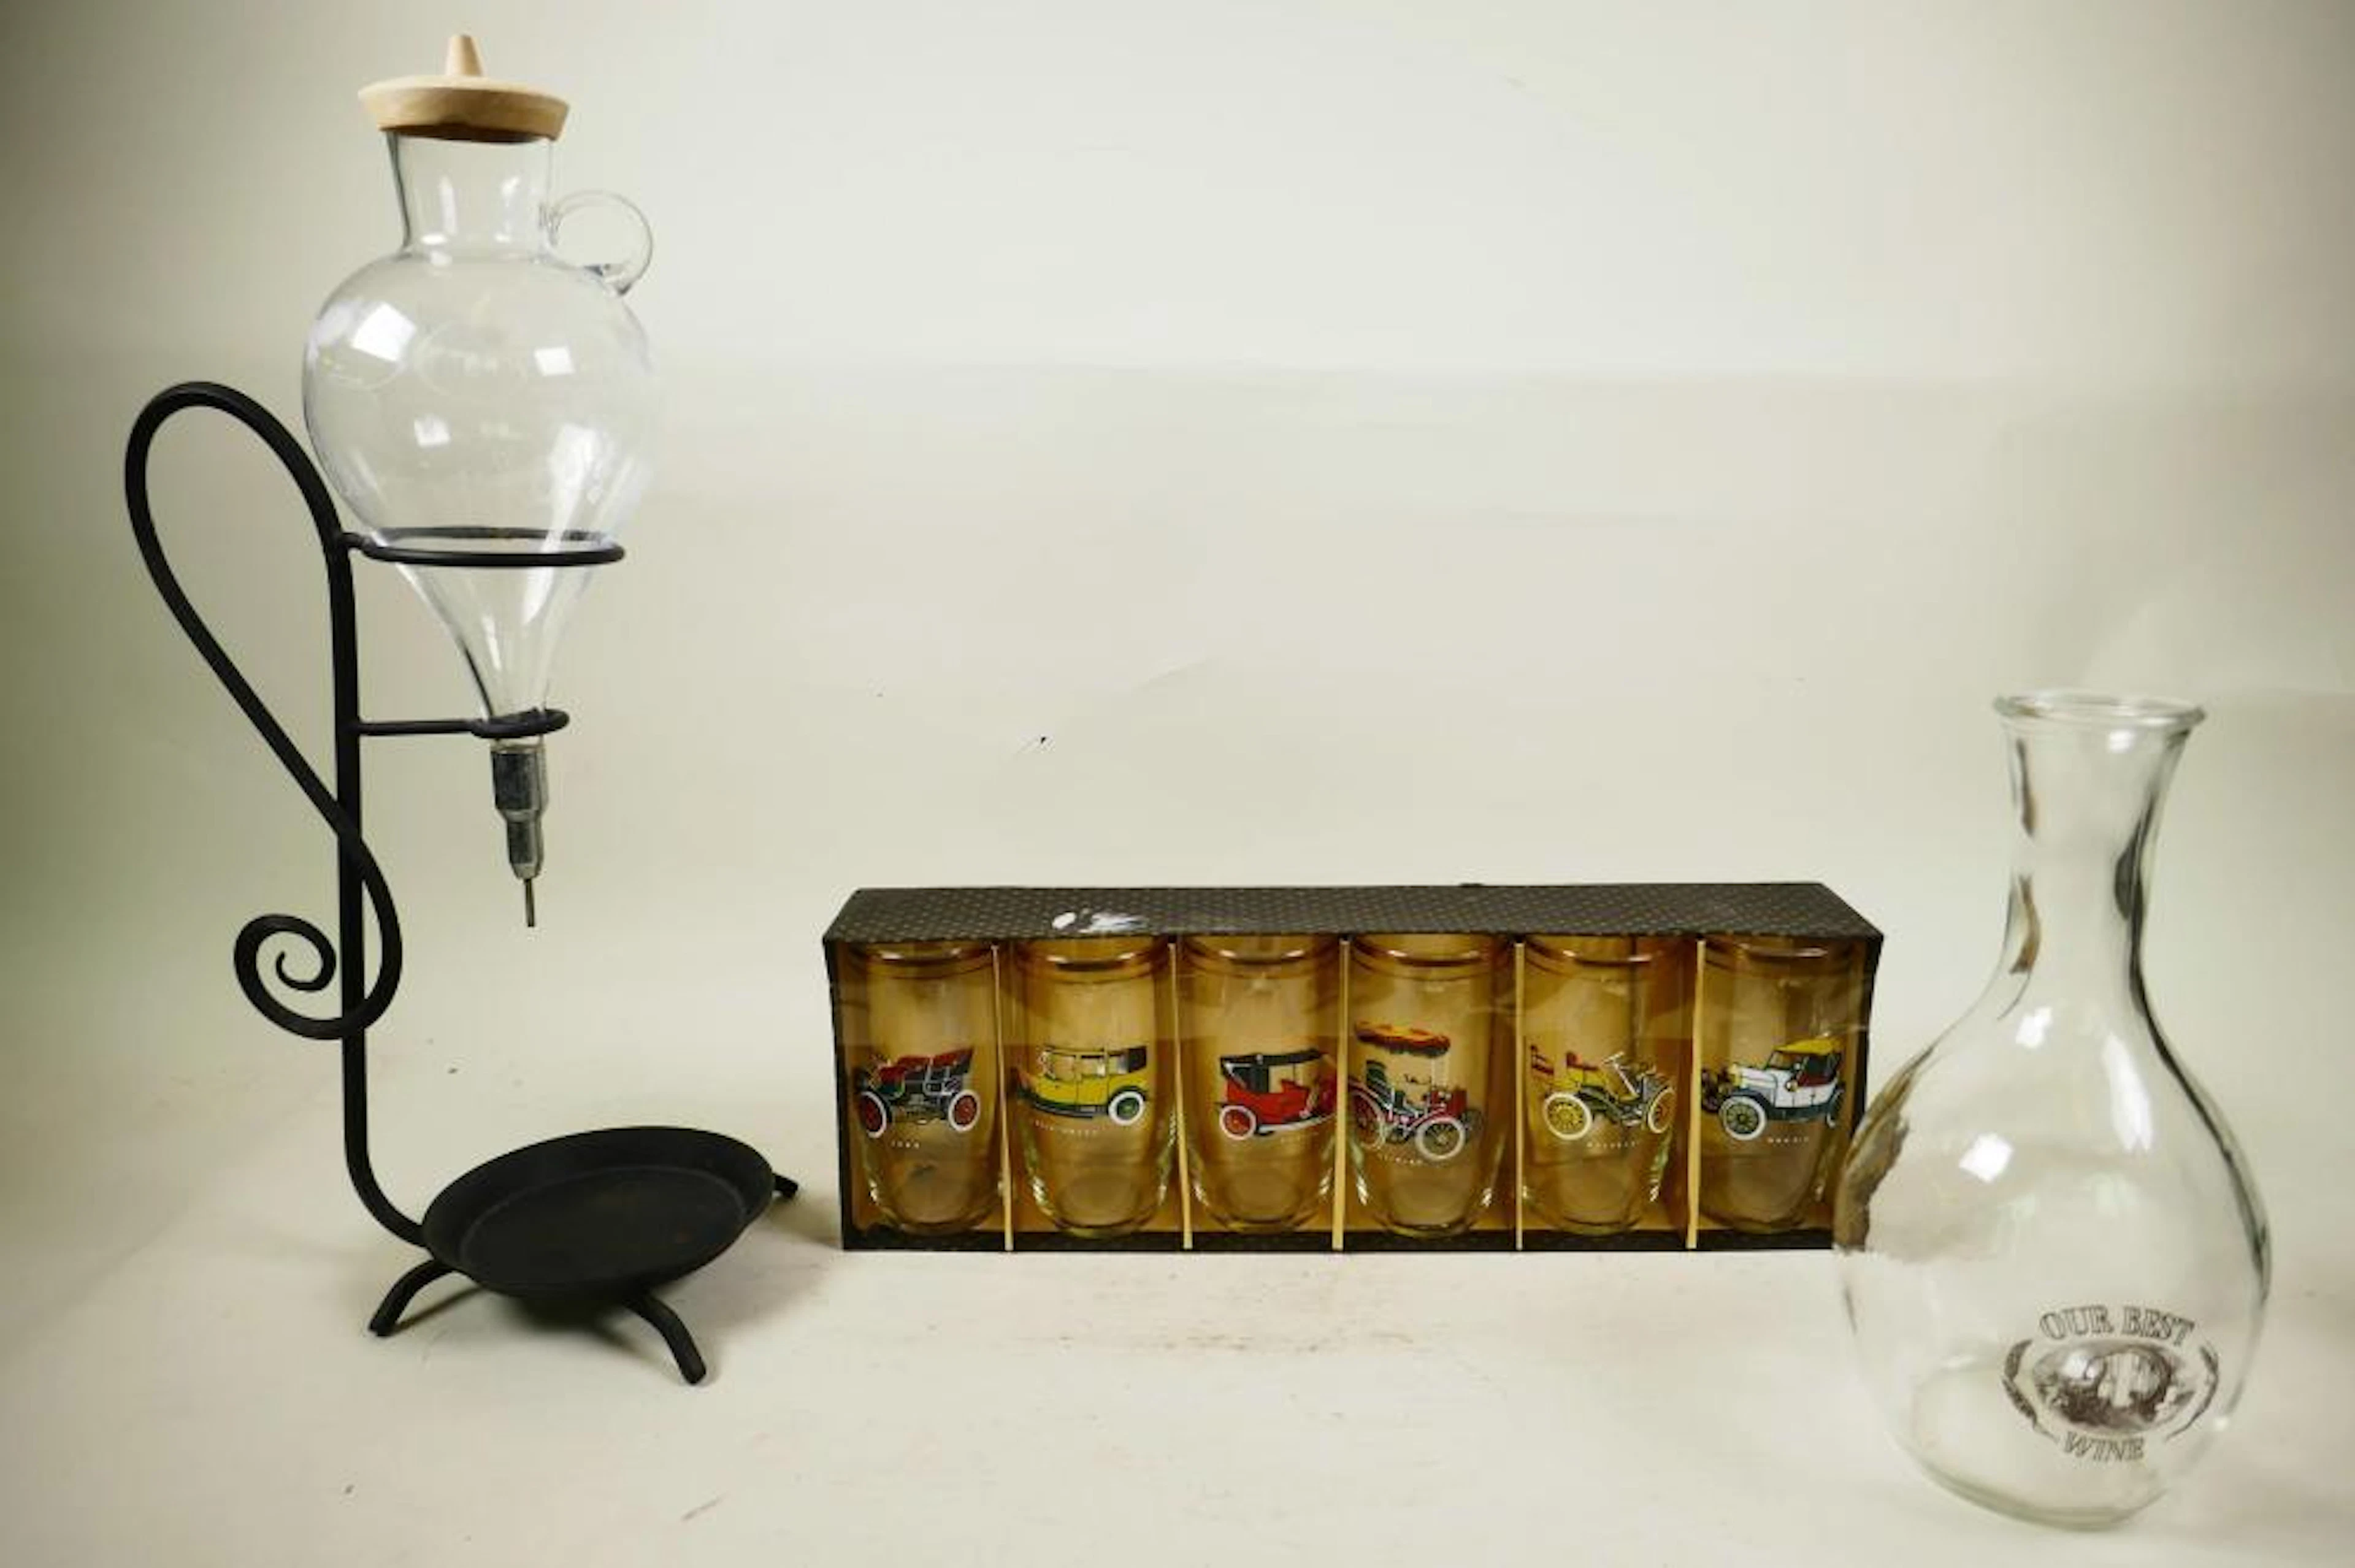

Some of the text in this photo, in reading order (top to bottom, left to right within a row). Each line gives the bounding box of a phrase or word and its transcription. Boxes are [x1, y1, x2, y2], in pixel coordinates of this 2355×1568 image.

[2039, 1306, 2195, 1346] OUR BEST
[2064, 1431, 2145, 1462] WINE
